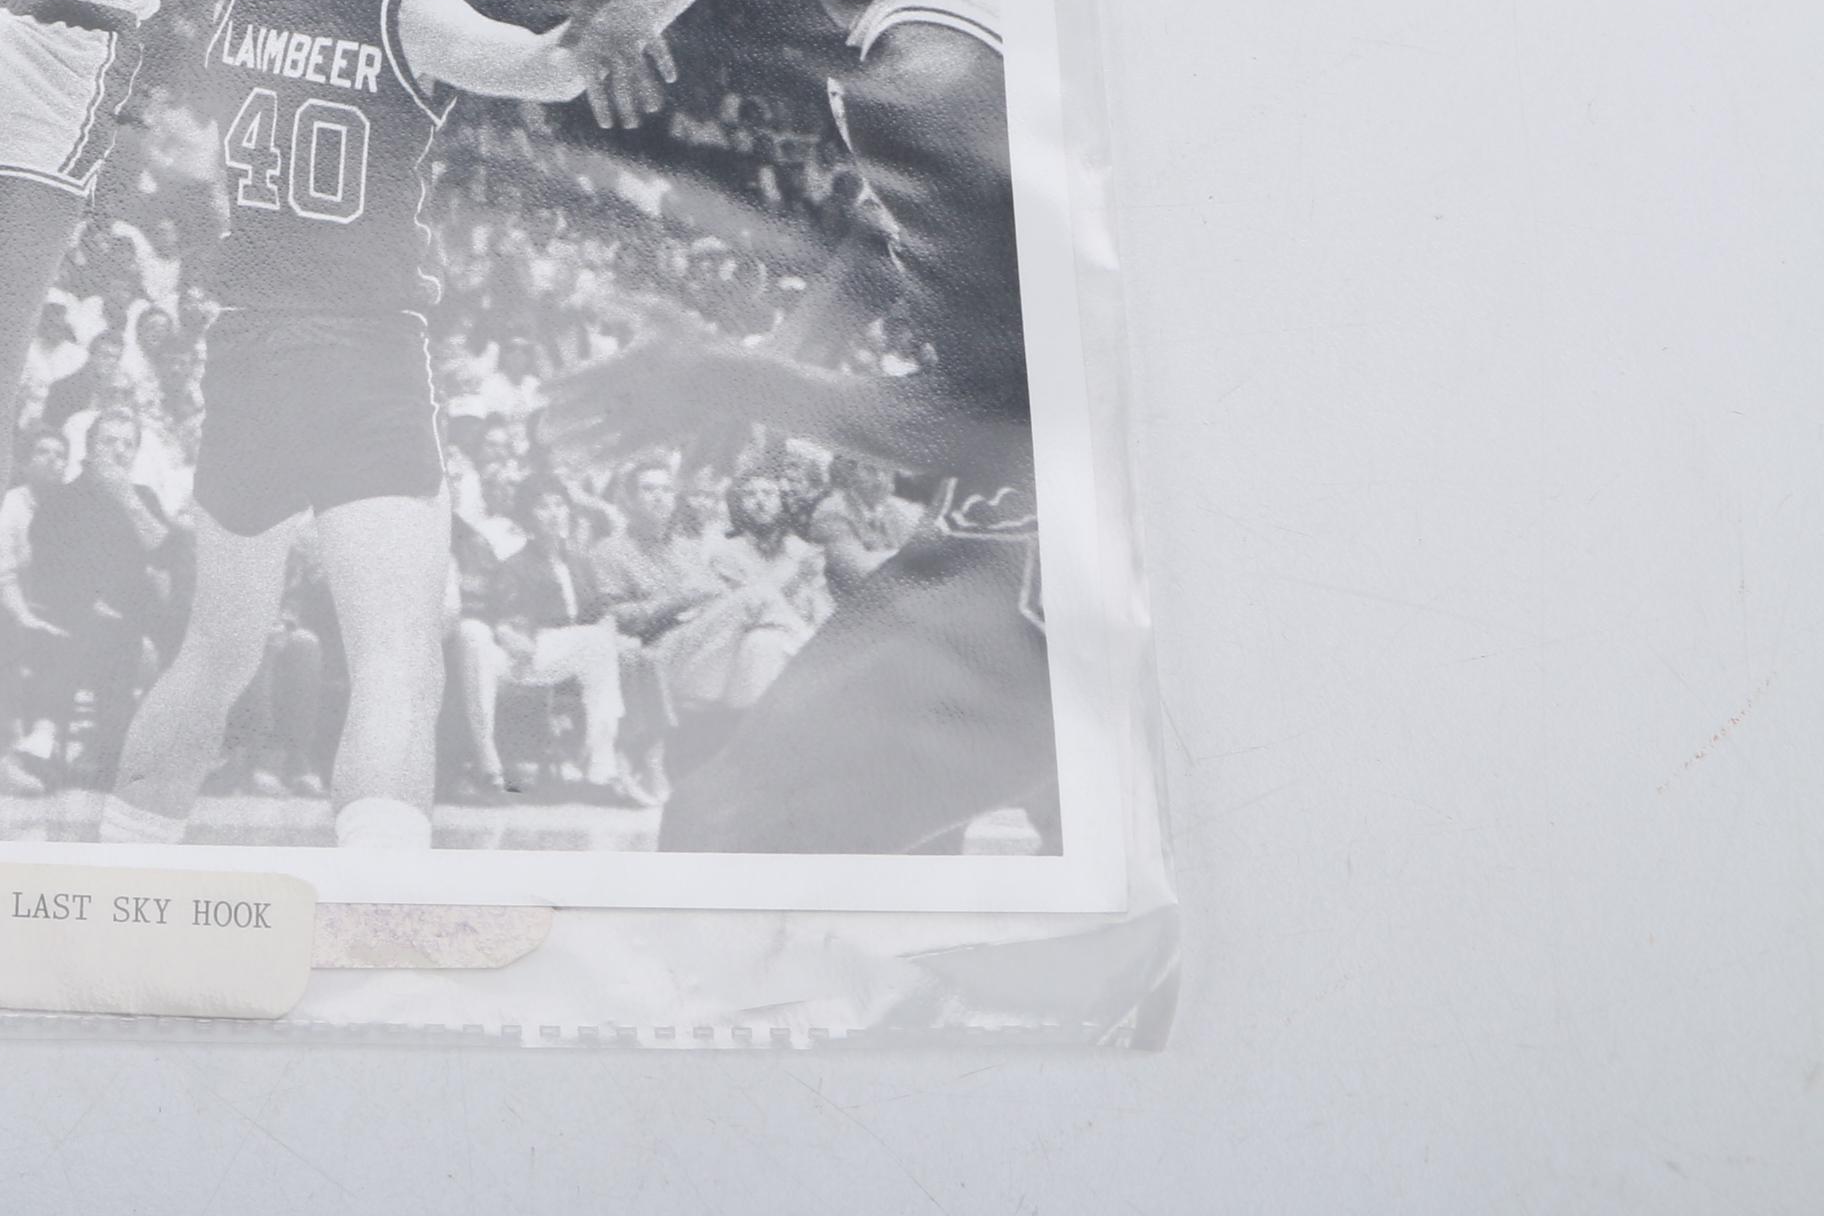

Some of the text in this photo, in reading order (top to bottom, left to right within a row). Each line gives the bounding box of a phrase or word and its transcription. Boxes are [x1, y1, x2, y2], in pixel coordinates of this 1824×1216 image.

[222, 20, 384, 94] LAIMBEER
[224, 87, 371, 225] 40
[12, 891, 92, 921] LAST
[112, 895, 172, 925] SKY
[191, 899, 272, 929] HOOK
